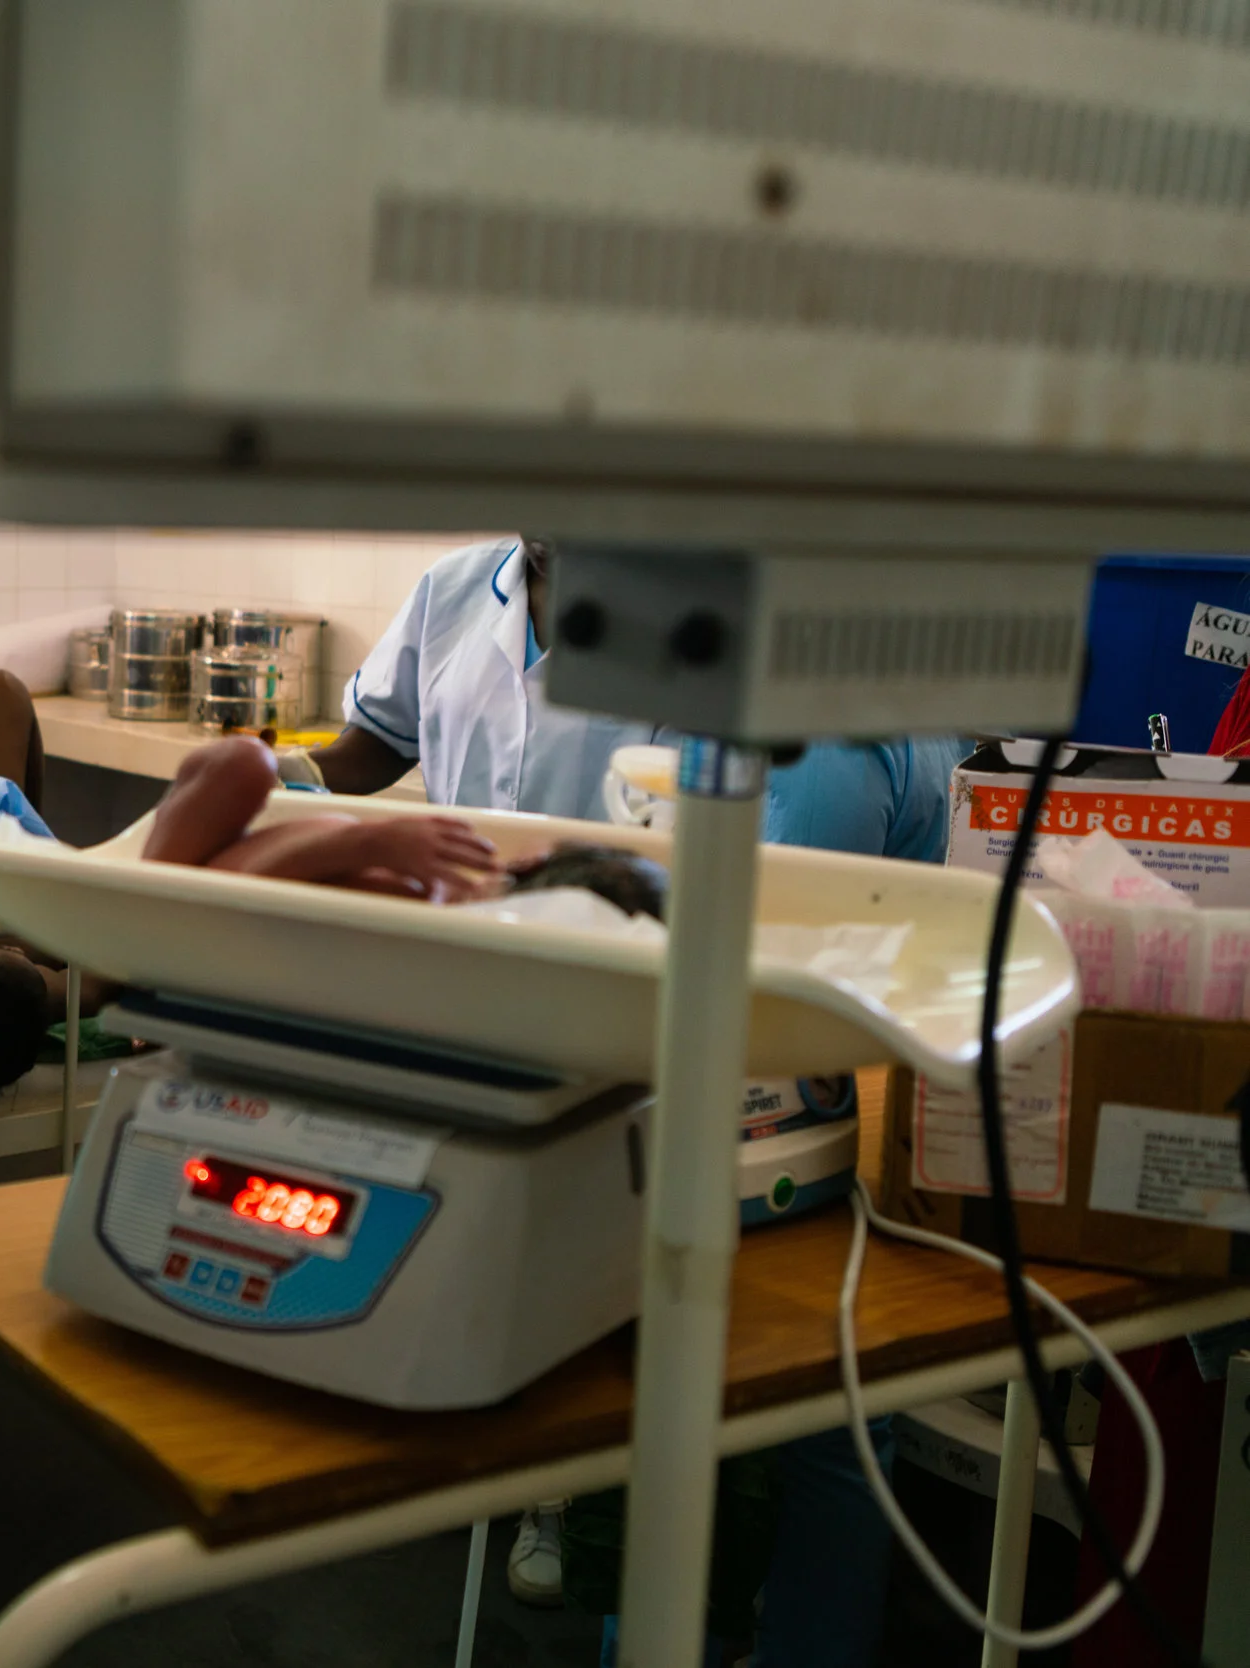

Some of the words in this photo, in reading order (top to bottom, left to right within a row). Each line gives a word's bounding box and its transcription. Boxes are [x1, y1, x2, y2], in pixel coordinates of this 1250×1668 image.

[1195, 606, 1250, 637] ÁGU
[1192, 640, 1248, 667] PARA
[991, 792, 1070, 807] LUAS
[1096, 799, 1124, 811] DE
[1150, 802, 1234, 817] LATEX
